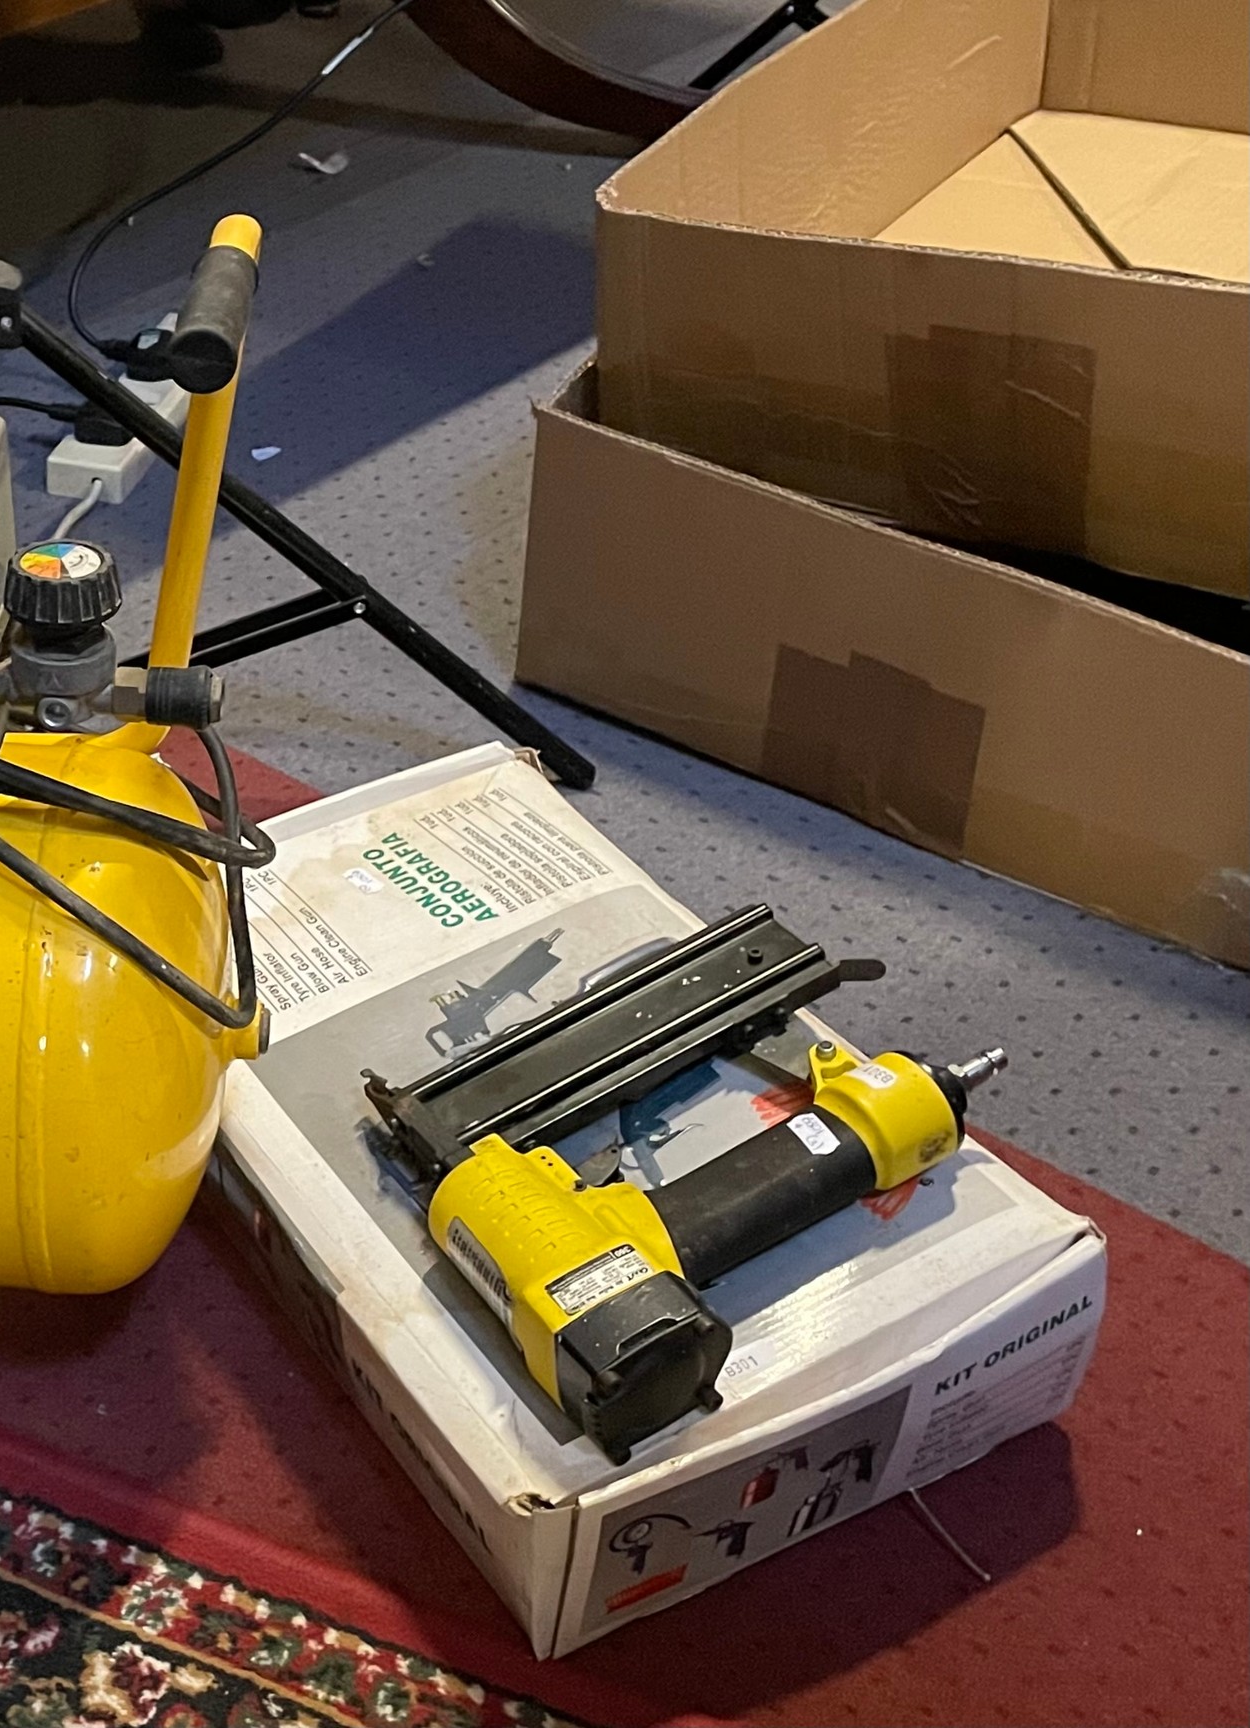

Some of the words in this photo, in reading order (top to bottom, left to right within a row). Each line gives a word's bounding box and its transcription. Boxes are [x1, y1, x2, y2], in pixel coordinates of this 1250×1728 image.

[511, 821, 544, 844] racores
[500, 833, 543, 863] sopladora
[542, 843, 561, 856] con
[493, 870, 507, 879] de
[508, 859, 521, 869] de
[556, 856, 591, 881] Espiral
[363, 849, 464, 928] CONJUNTO
[381, 832, 500, 922] AEROGRAFIA
[519, 869, 555, 896] Inflador
[480, 881, 519, 913] Incluye:
[316, 924, 340, 948] Clean
[263, 952, 294, 983] Inflator
[290, 952, 309, 971] Gun
[311, 947, 334, 970] Hose
[338, 948, 368, 977] Engine
[254, 966, 268, 984] Gu
[307, 971, 330, 994] Blow
[333, 971, 351, 985] Air
[265, 984, 292, 1011] Spray
[291, 982, 309, 1002] Tyre
[934, 1362, 978, 1396] KIT
[983, 1295, 1093, 1369] ORIGINAL
[724, 1355, 759, 1377] B301
